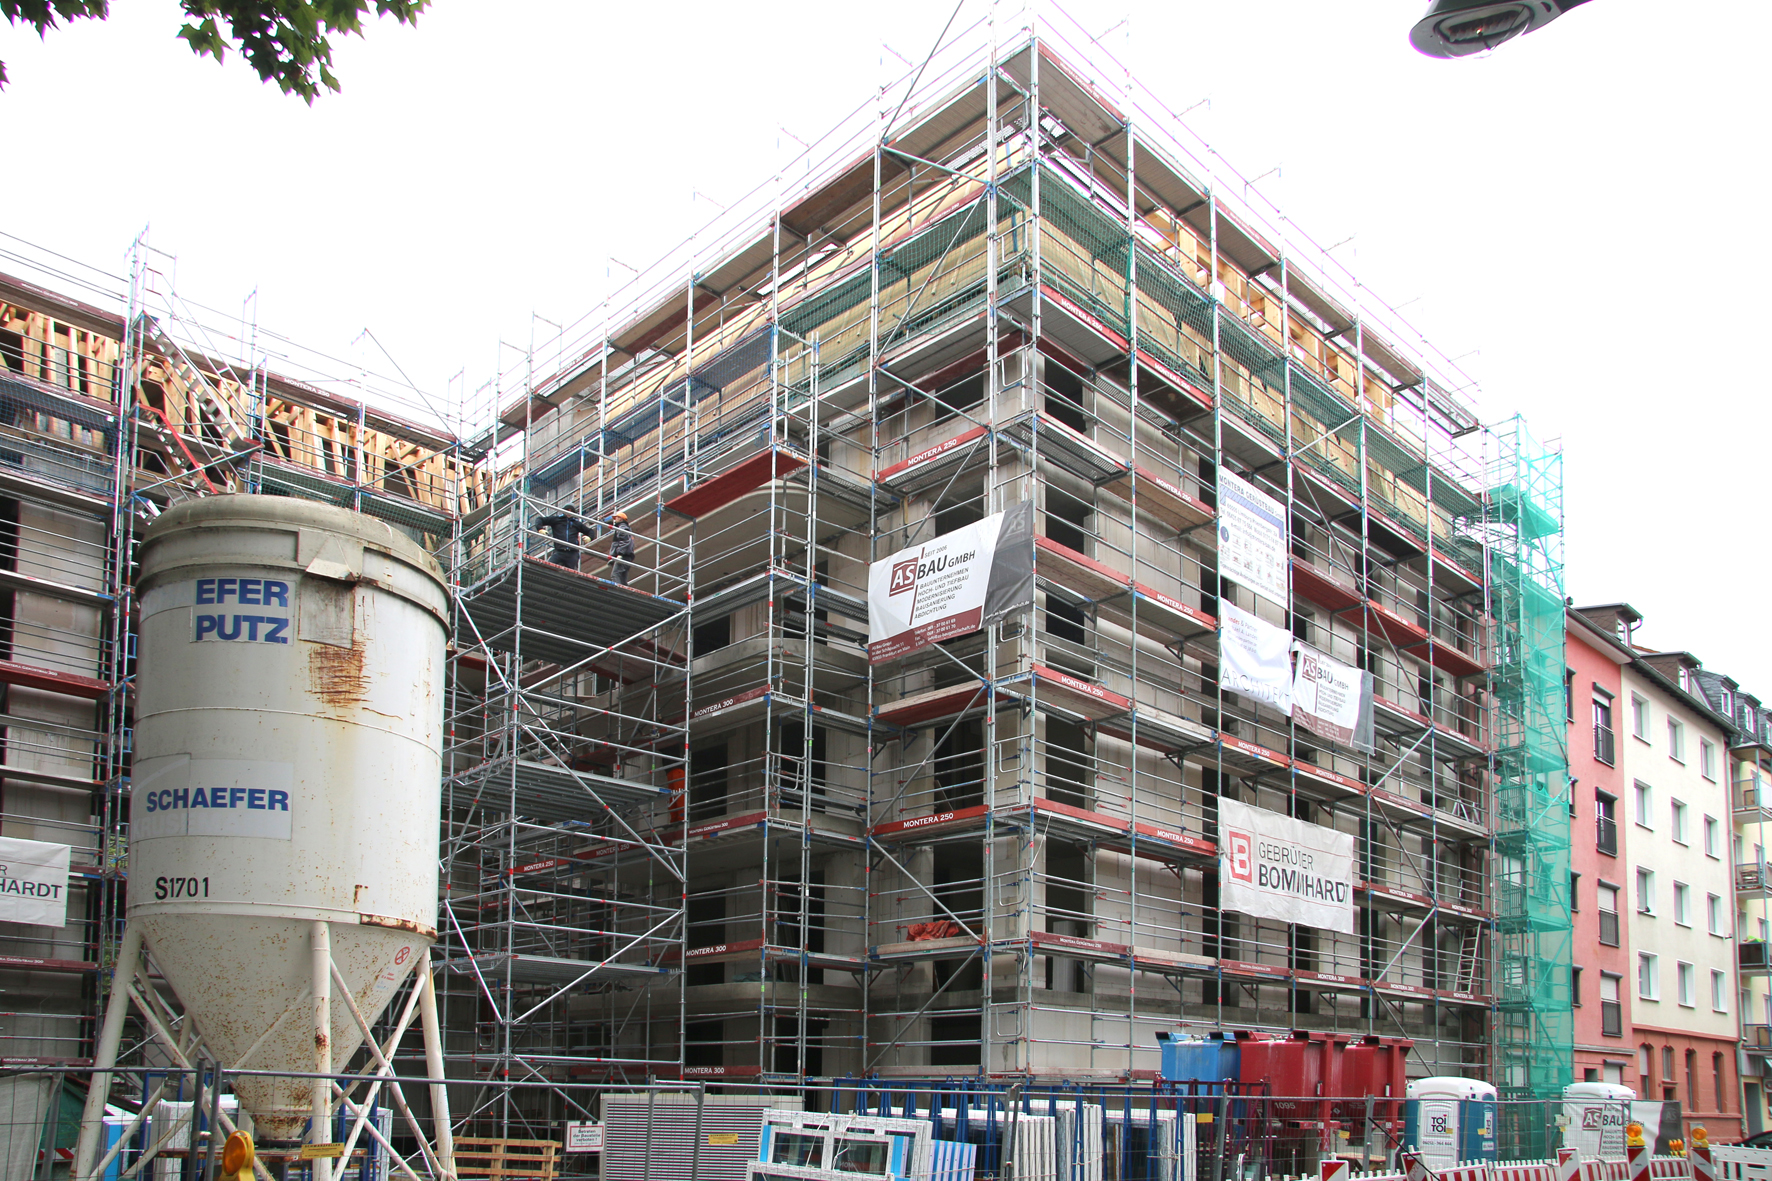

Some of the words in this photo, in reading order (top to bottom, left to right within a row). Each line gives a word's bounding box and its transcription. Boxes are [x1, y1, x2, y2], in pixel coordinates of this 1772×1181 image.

[1061, 299, 1092, 325] MONTERA
[284, 378, 317, 394] MONTERA
[907, 446, 941, 466] MONTERA
[943, 439, 957, 449] 250
[1156, 477, 1181, 497] MONTERA
[1219, 474, 1244, 495] MONTERA
[924, 550, 935, 558] SEIT
[892, 565, 915, 589] AS
[917, 555, 948, 580] BAU
[948, 550, 976, 568] GMBH
[920, 567, 969, 589] BAUUNTERNEHMEN
[934, 582, 946, 591] UND
[946, 574, 970, 587] TIEFBAU
[196, 578, 289, 608] EFER
[915, 594, 956, 612] BAUSANIERUNG
[916, 584, 963, 604] MODERNISIERUNG
[914, 604, 947, 619] ABDICHTUNG
[1157, 594, 1183, 611] MONTERA
[1184, 606, 1194, 615] 250
[196, 614, 289, 644] PUTZ
[1304, 657, 1316, 677] AS
[1317, 667, 1333, 684] BAU
[1061, 676, 1091, 692] MONTERA
[1092, 688, 1103, 697] 250
[694, 703, 721, 716] MONTERA
[1238, 741, 1260, 753] MONTERA
[146, 787, 289, 813] SCHAEFER
[903, 816, 939, 828] MONTERA
[1157, 830, 1183, 842] MONTERA
[1184, 836, 1194, 844] 250
[523, 862, 545, 871] MONTERA
[155, 876, 209, 900] S1701
[686, 948, 714, 956] MONTERA
[1584, 1113, 1600, 1126] AS
[1602, 1115, 1624, 1126] BAU
